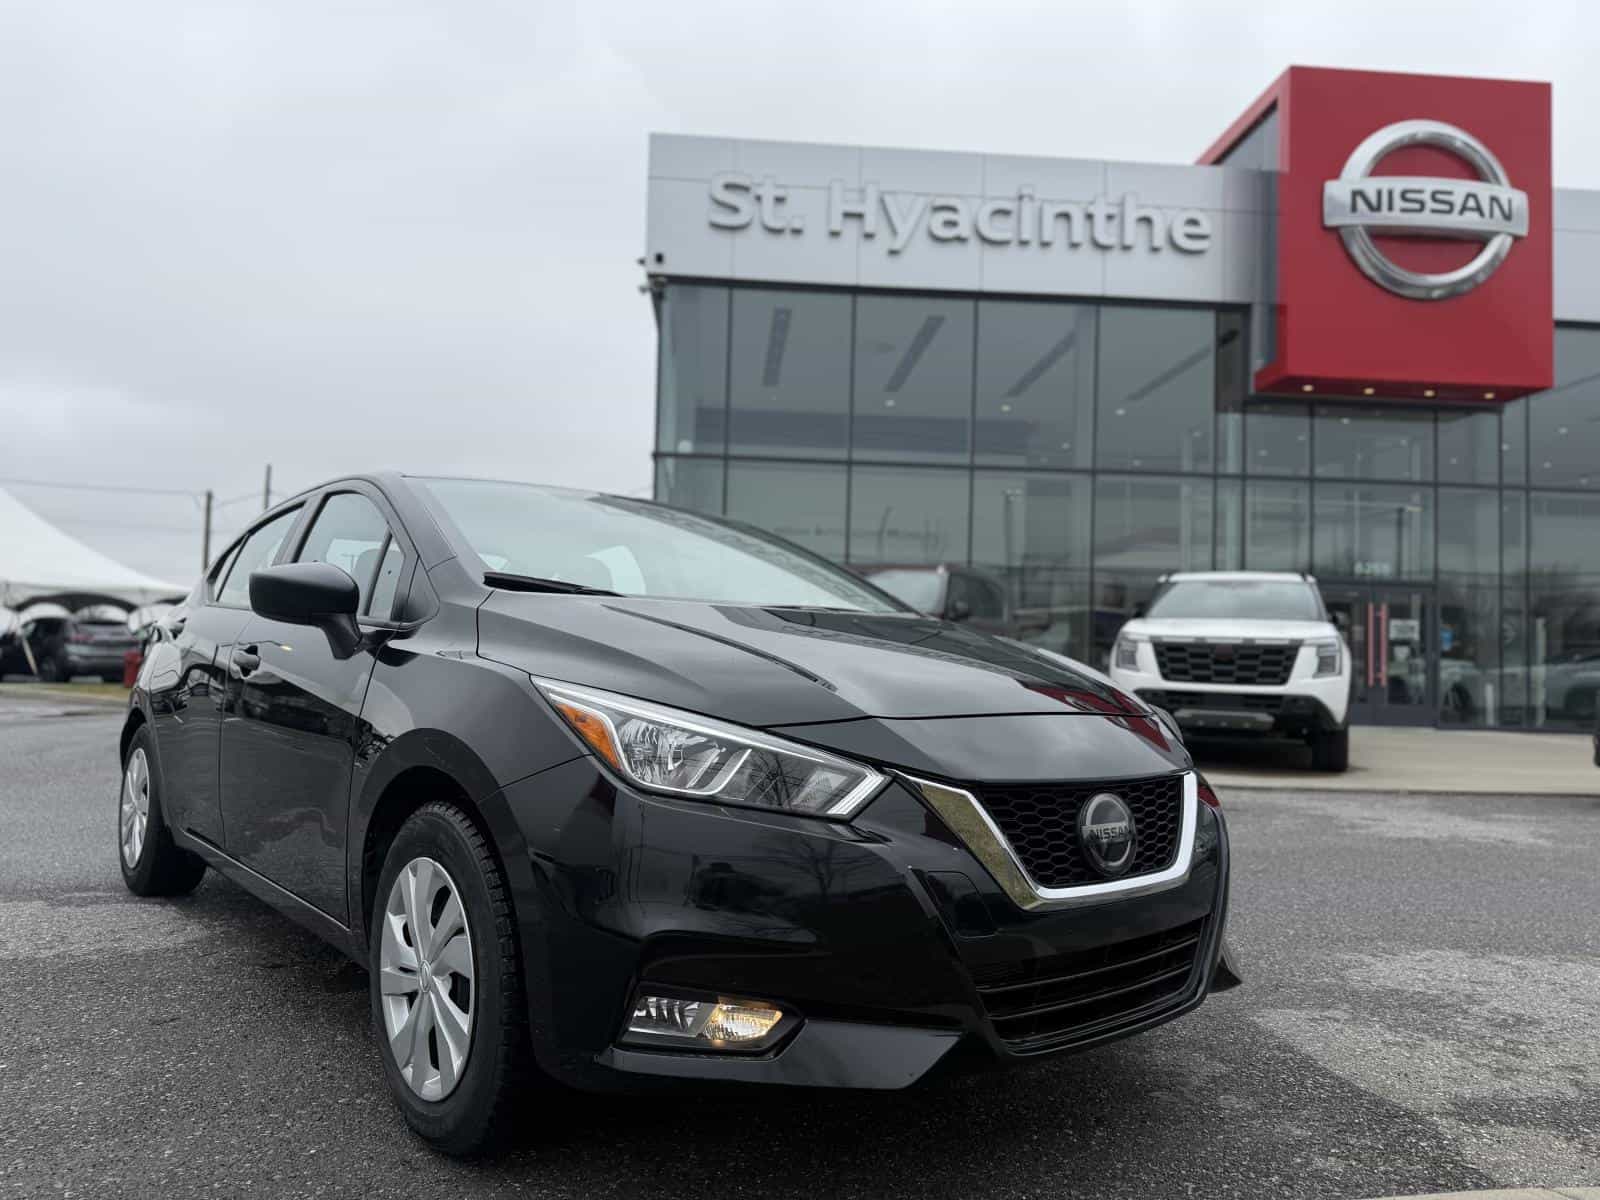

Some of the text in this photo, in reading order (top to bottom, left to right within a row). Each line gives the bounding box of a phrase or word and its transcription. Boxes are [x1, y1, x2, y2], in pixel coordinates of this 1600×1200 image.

[709, 171, 1213, 257] St. Hyacinthe
[1350, 187, 1514, 222] NISSAN
[1089, 826, 1132, 841] NISSAN
